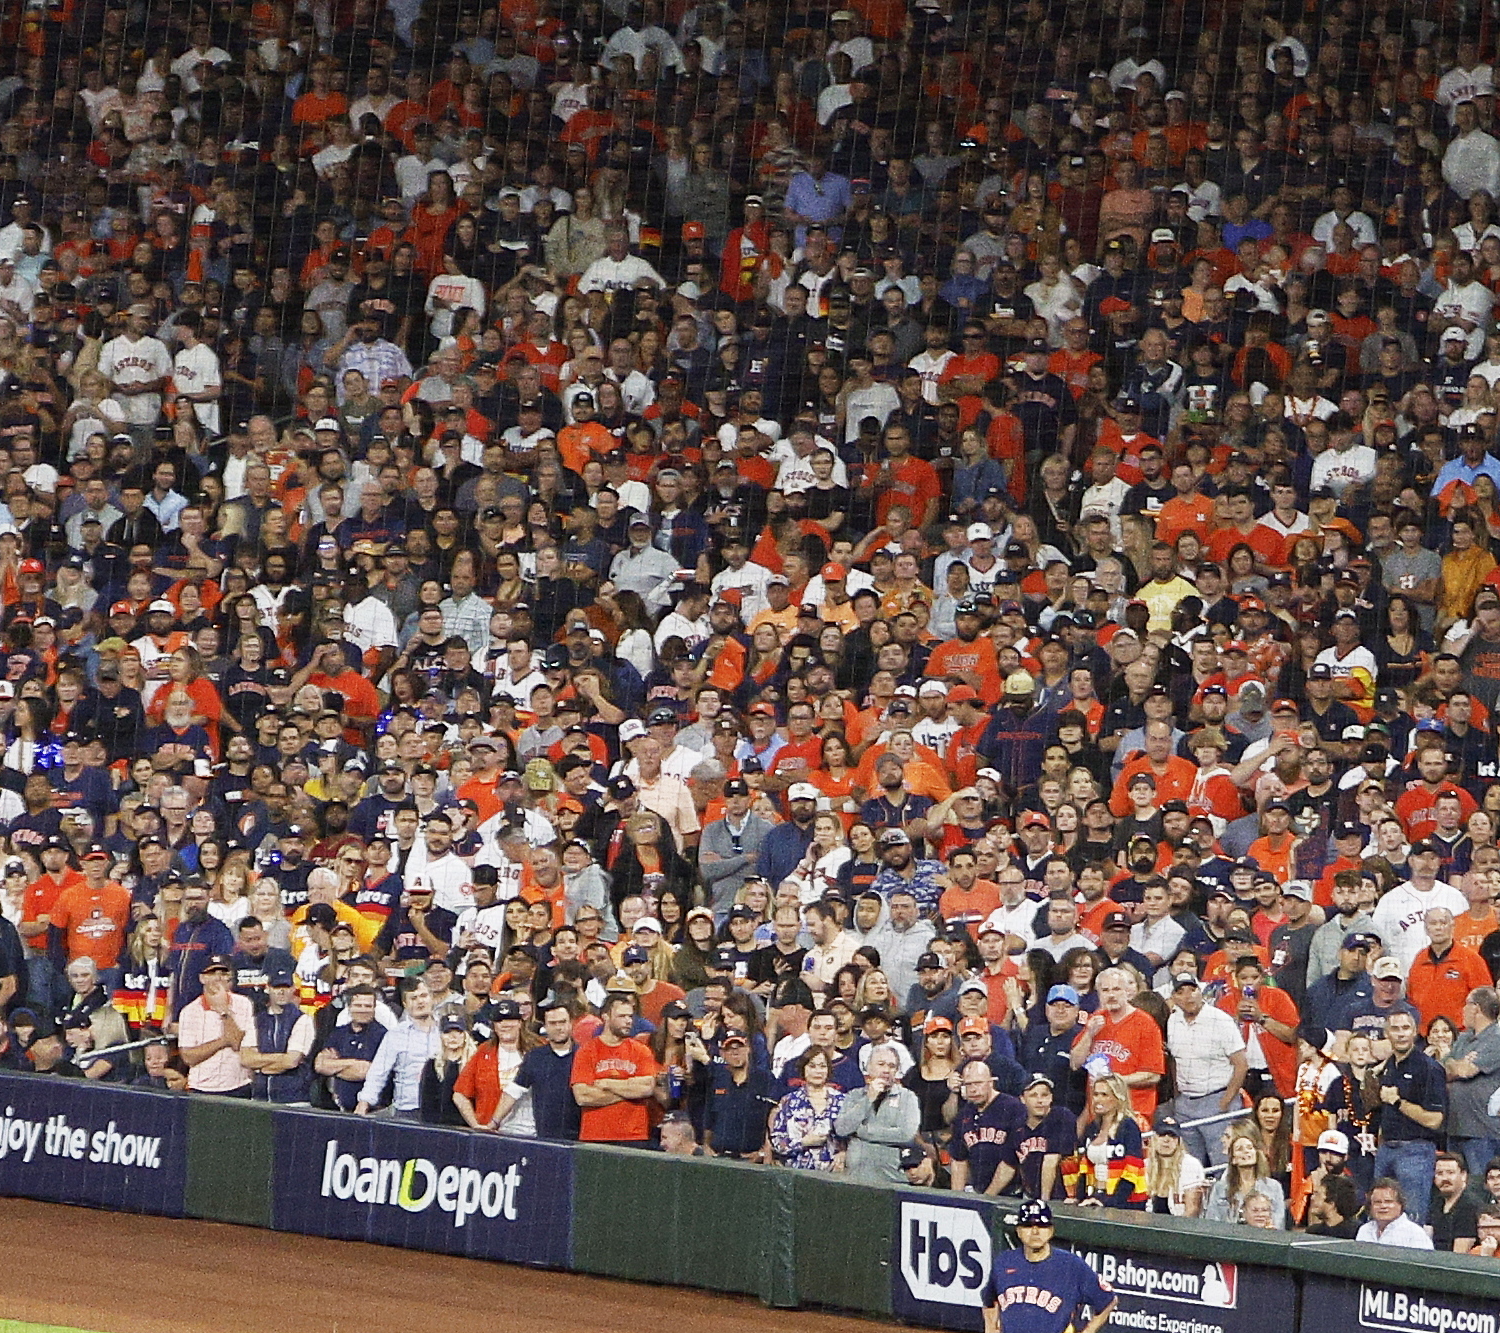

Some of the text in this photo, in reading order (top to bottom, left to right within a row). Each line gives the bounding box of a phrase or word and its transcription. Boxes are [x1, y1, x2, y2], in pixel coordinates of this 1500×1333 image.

[44, 1115, 85, 1159] the
[89, 1129, 161, 1169] show.
[321, 1139, 520, 1227] loanDepot
[909, 1219, 983, 1289] tbs
[997, 1286, 1063, 1313] ASTROS
